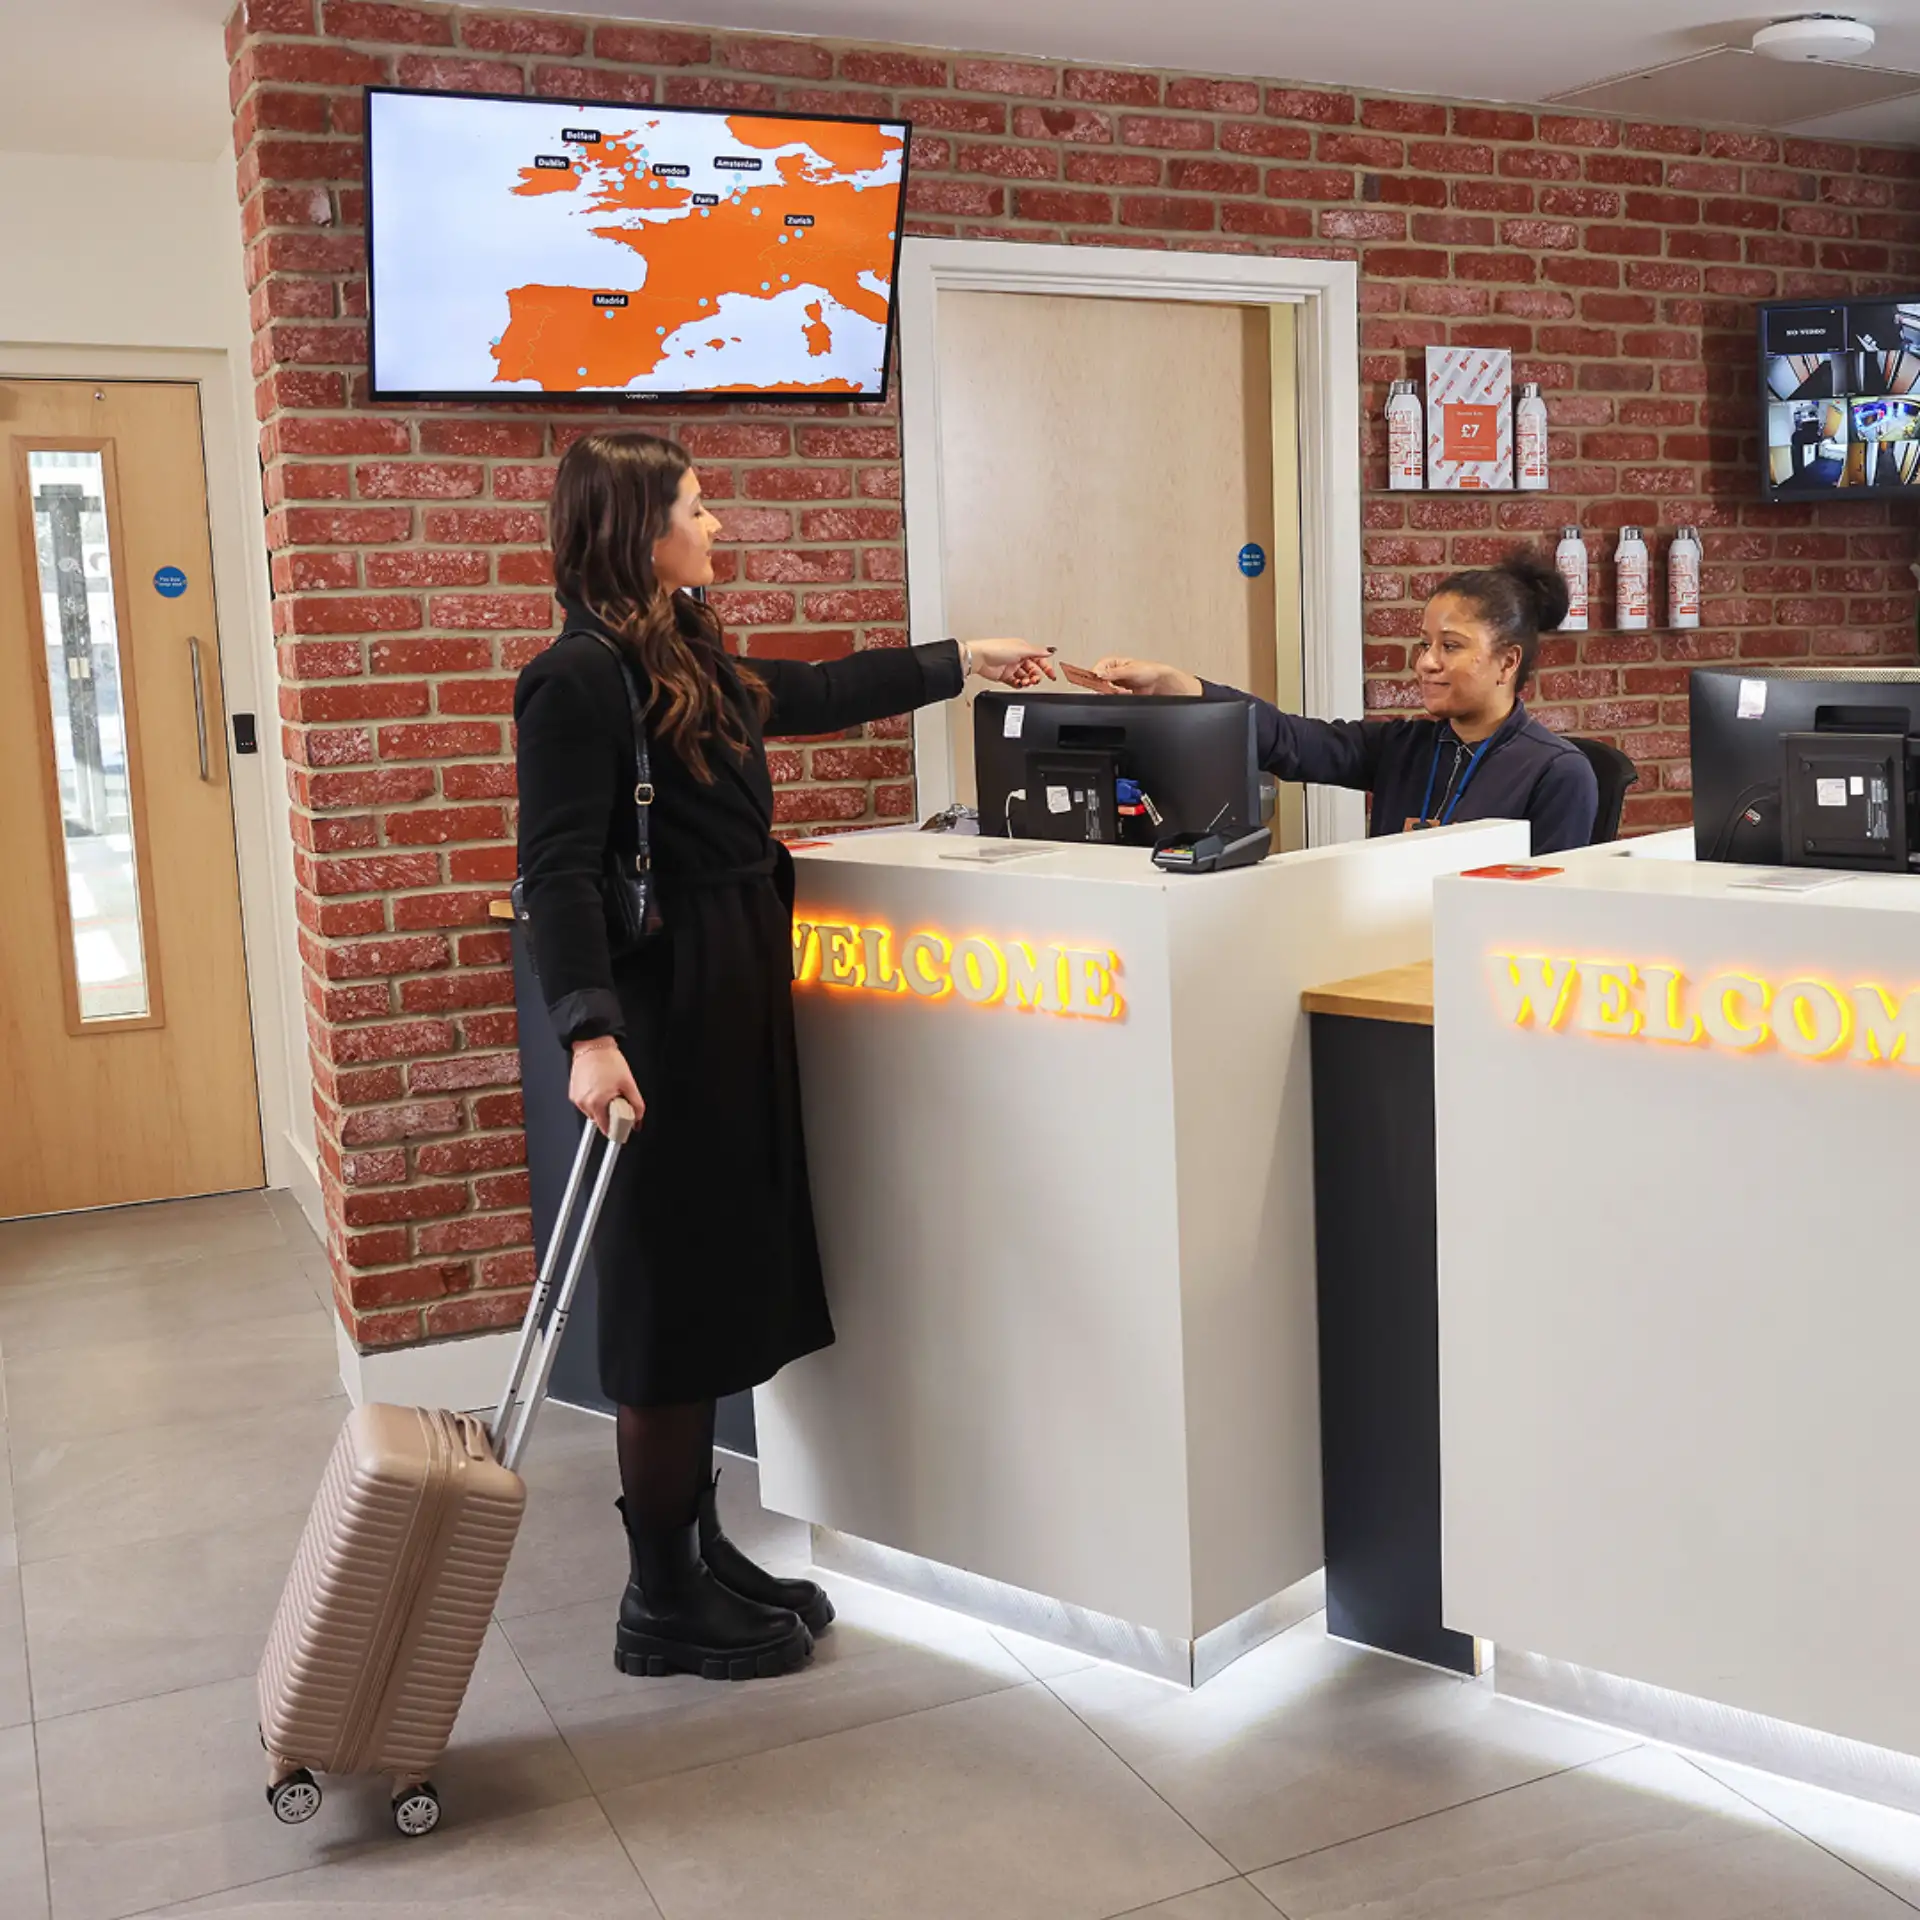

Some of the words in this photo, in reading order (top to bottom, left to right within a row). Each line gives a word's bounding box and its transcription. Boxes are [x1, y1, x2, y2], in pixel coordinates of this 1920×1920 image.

[538, 159, 566, 168] Dublin
[716, 160, 760, 169] Amsterdam
[655, 166, 687, 176] London
[787, 216, 812, 225] Zurich
[595, 296, 625, 305] Madrid
[1460, 424, 1480, 439] £7
[793, 922, 1122, 1019] ELCOME
